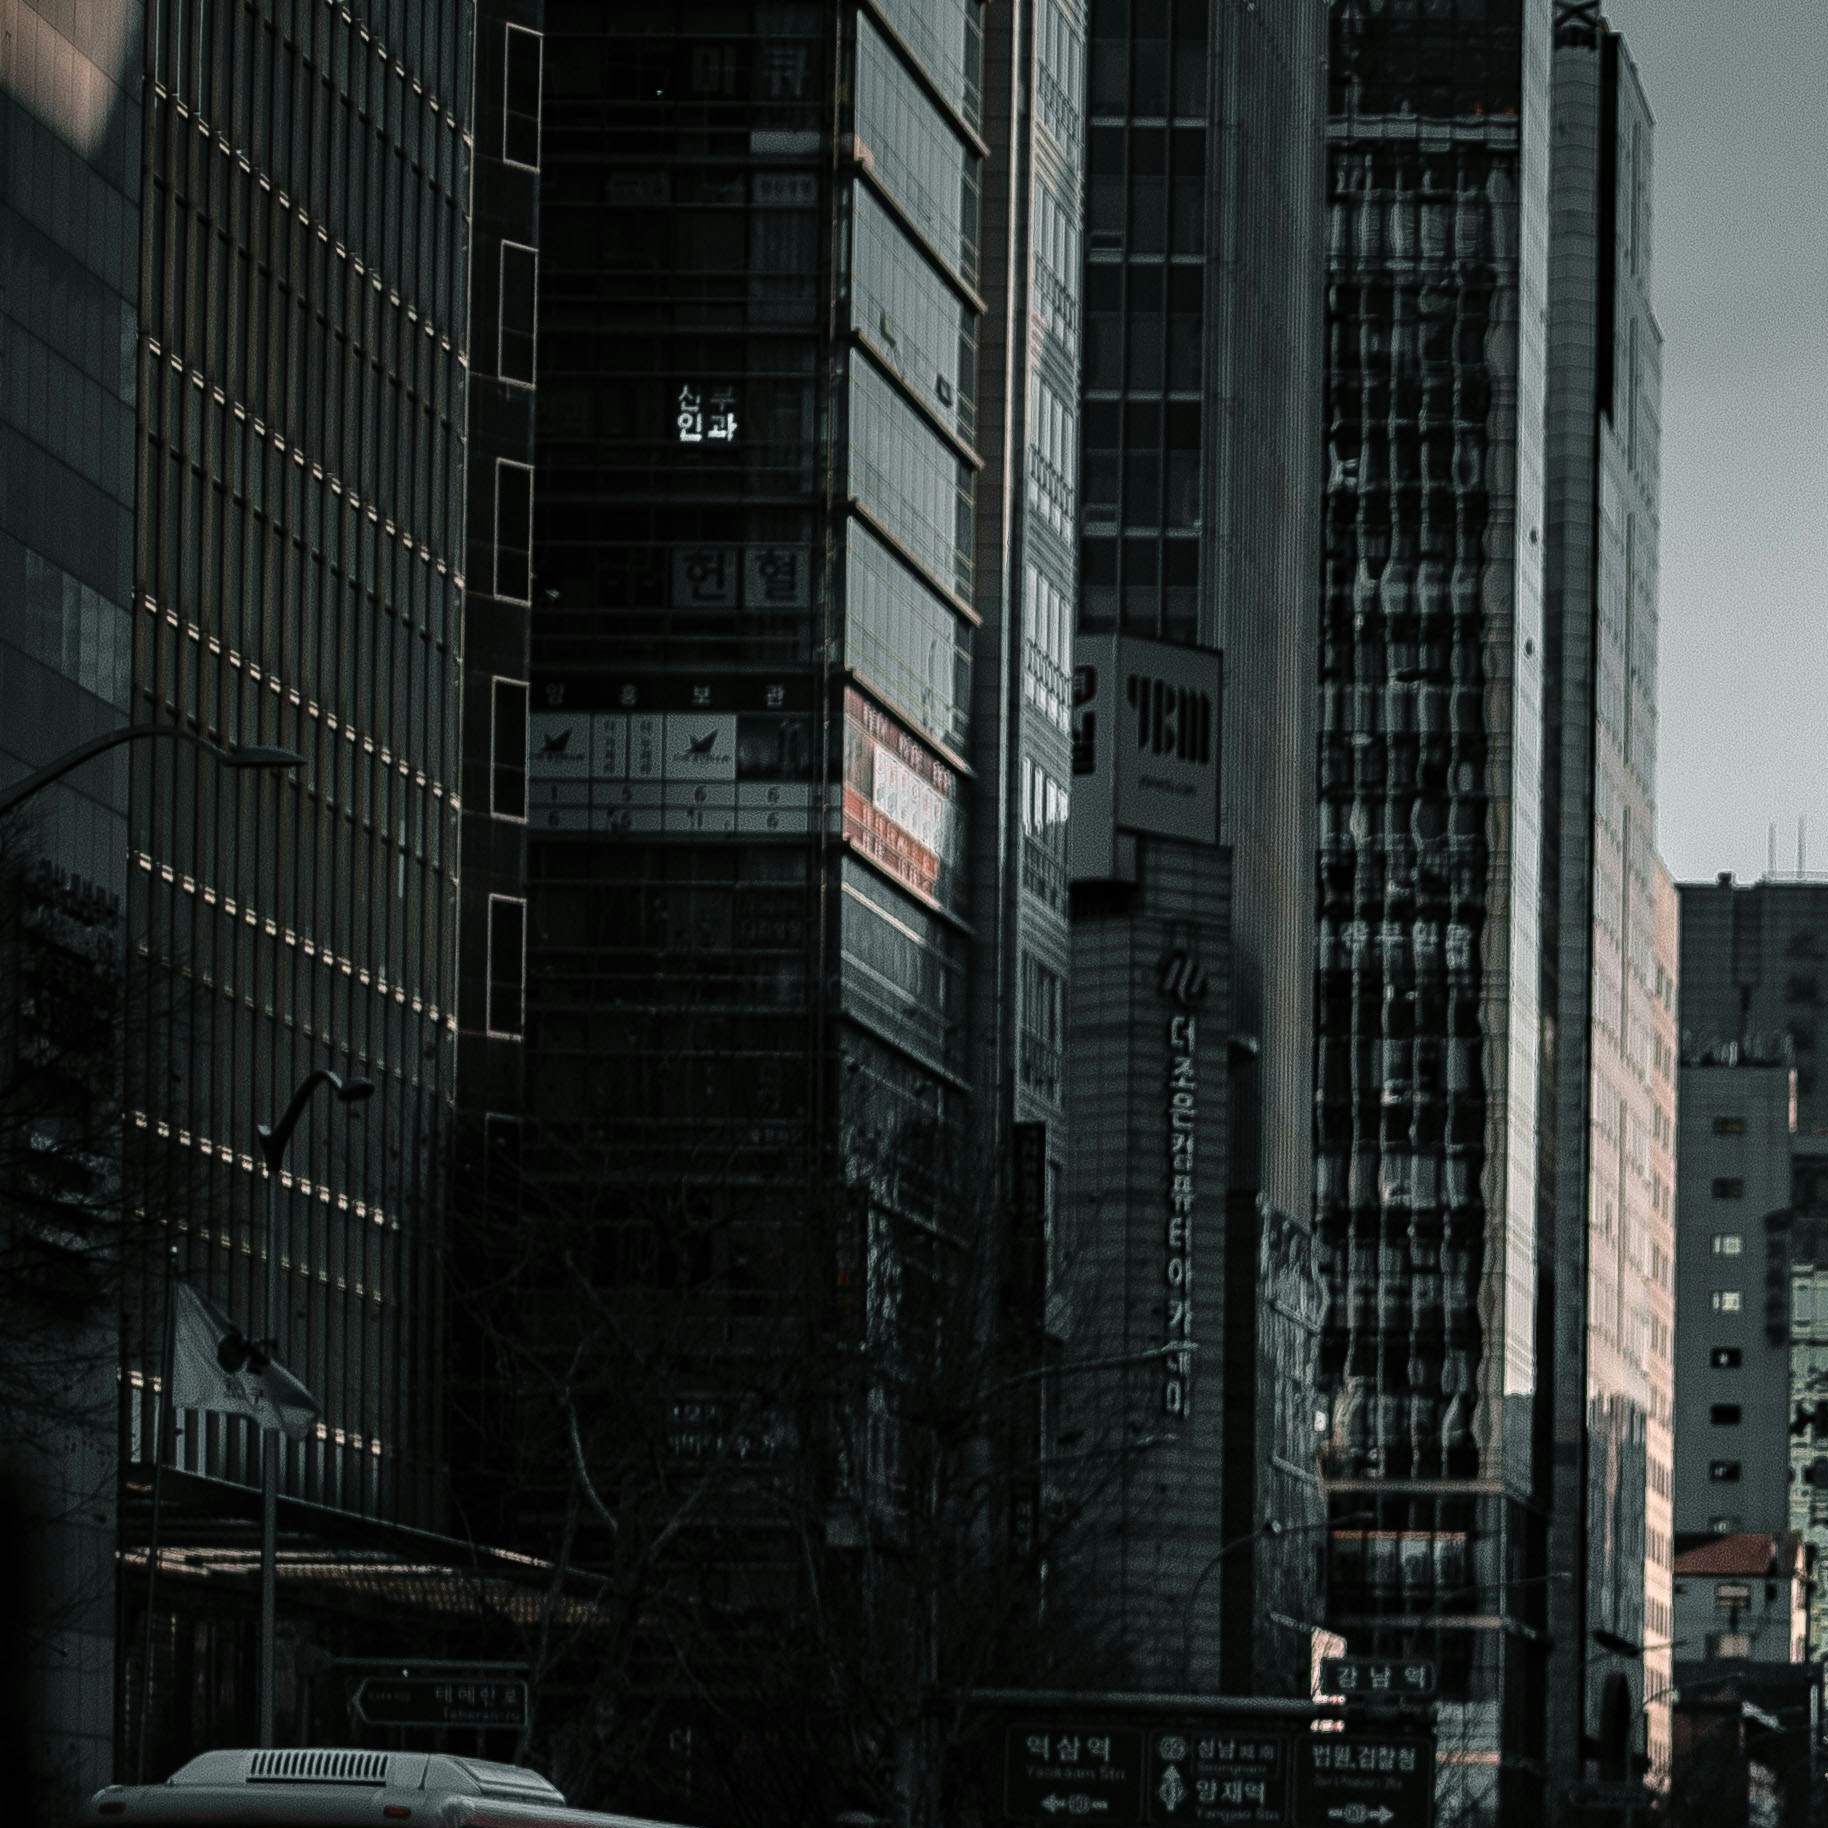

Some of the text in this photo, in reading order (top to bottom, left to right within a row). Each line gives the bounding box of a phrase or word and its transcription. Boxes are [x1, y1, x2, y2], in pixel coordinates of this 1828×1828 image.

[1336, 1666, 1426, 1689] 강남역
[1025, 1734, 1111, 1762] 역삼역
[1196, 1779, 1266, 1806] 양재역
